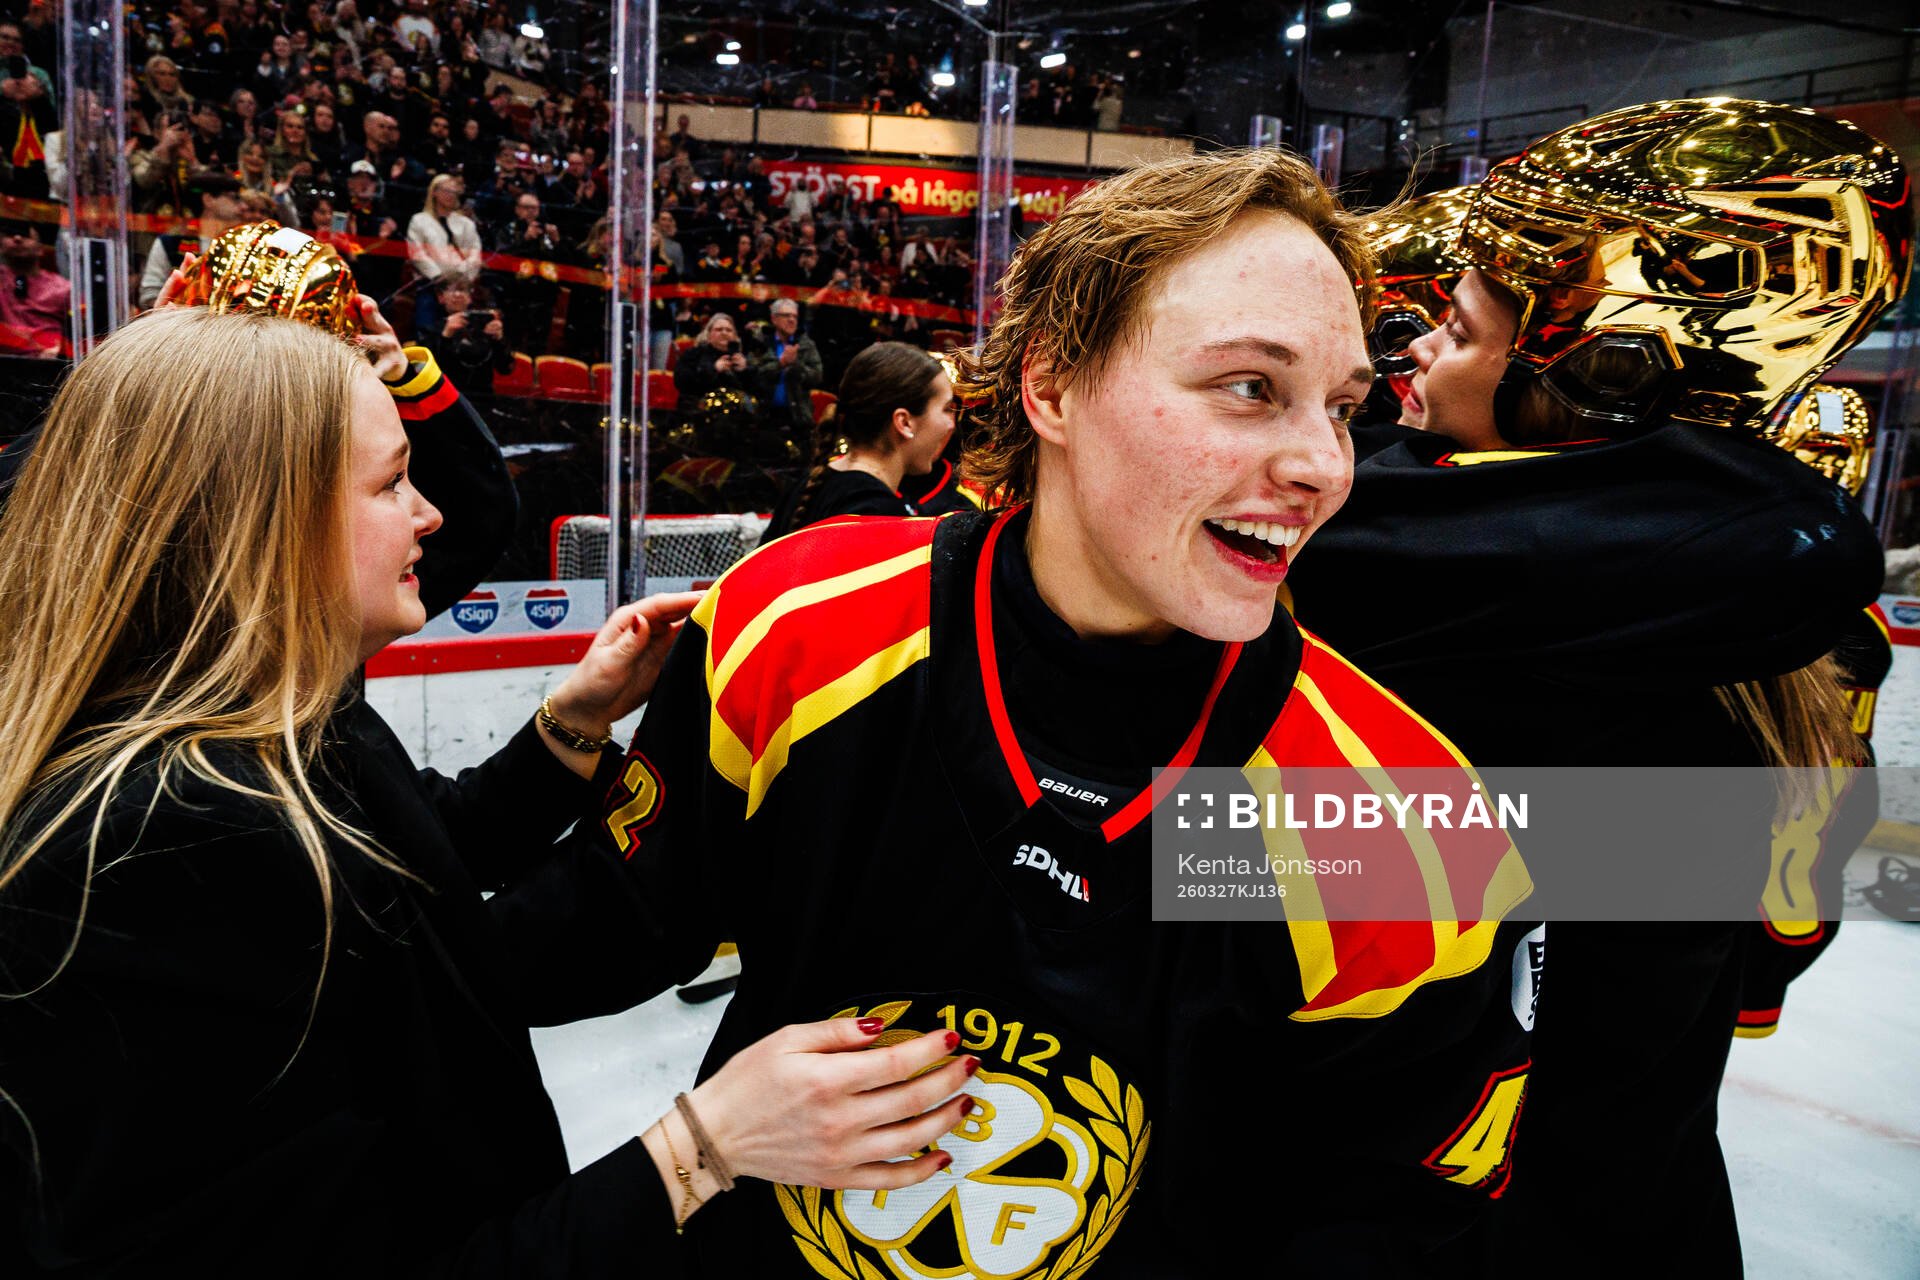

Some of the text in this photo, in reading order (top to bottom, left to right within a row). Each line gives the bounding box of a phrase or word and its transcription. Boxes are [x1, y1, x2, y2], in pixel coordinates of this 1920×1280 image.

[457, 605, 494, 625] 4Sign
[530, 602, 565, 621] 4Sign
[1038, 777, 1109, 807] BAUER
[1012, 844, 1089, 903] SDHL
[936, 1004, 1061, 1077] 1912
[990, 1202, 1037, 1246] F
